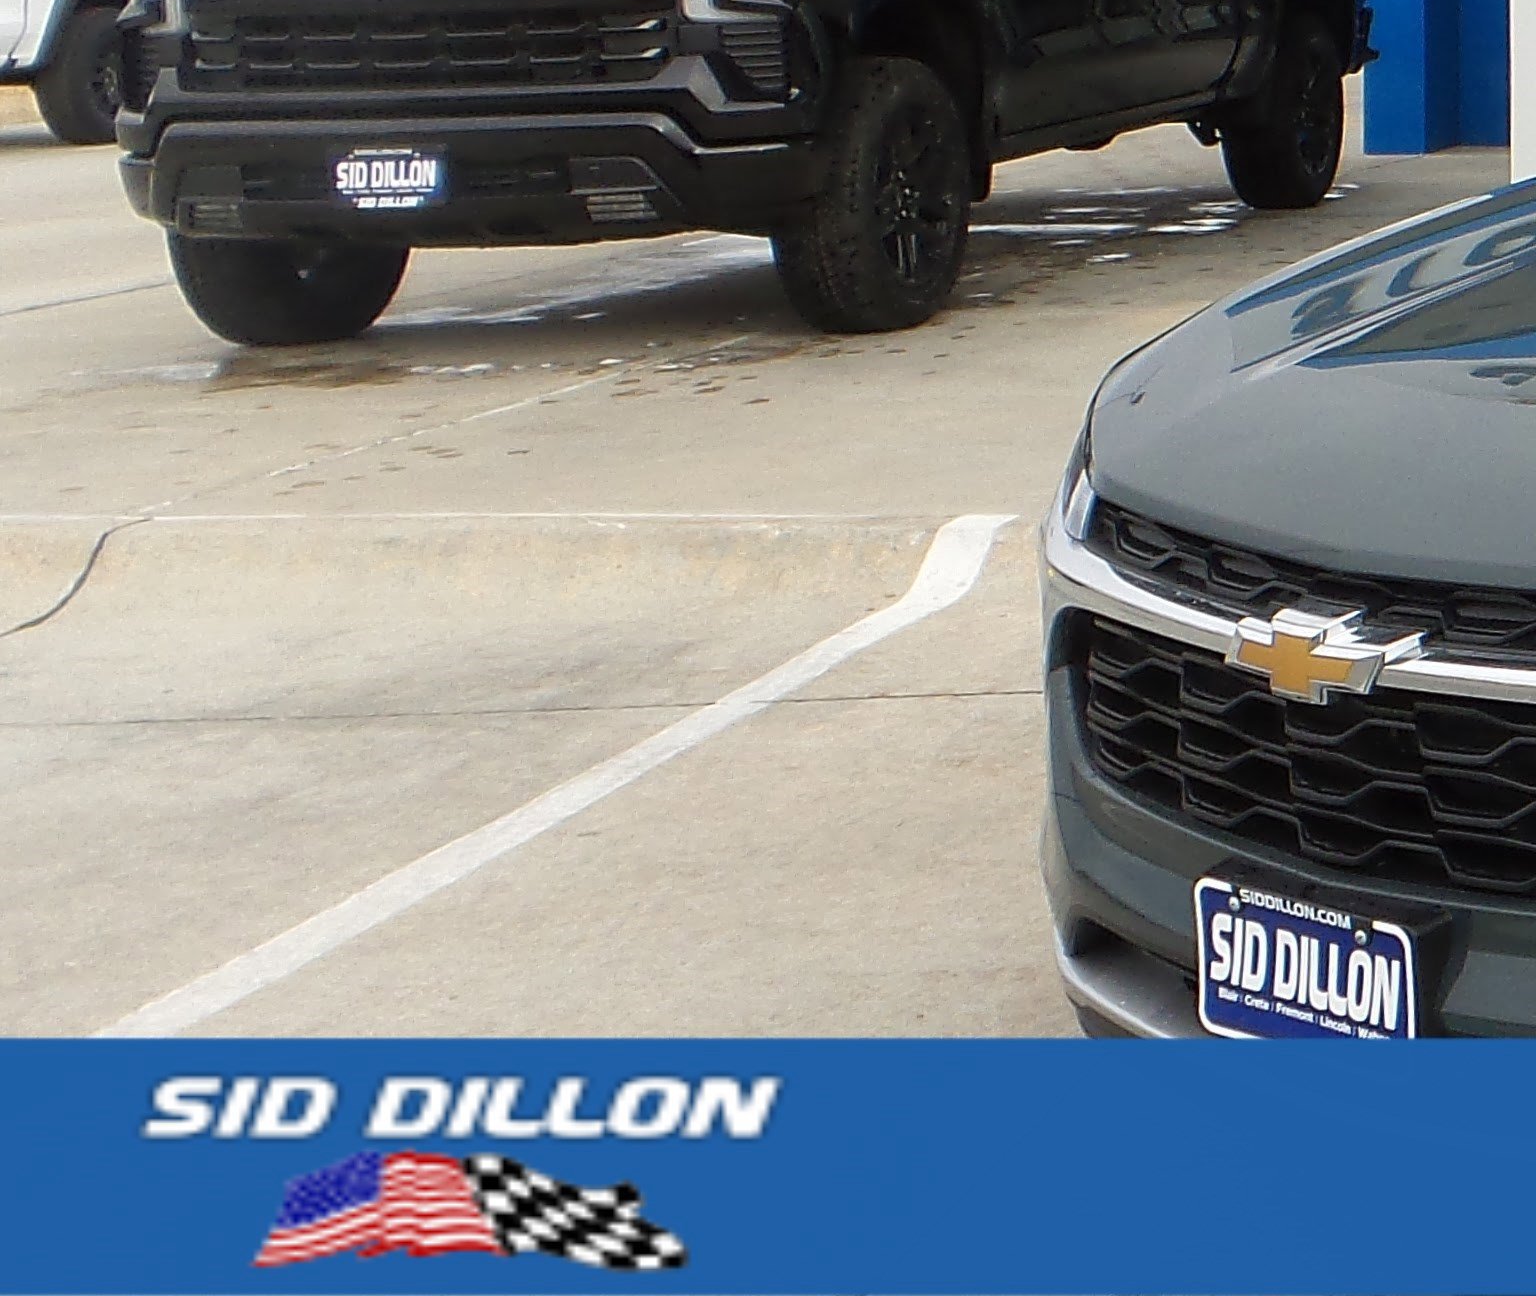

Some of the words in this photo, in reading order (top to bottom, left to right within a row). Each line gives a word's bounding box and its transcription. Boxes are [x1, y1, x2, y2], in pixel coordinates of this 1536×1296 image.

[336, 160, 367, 189] SID
[370, 159, 437, 188] DILLON
[1238, 888, 1352, 930] SIDDILLON.COM
[1210, 912, 1267, 993] SID
[1273, 928, 1401, 1031] DILLON
